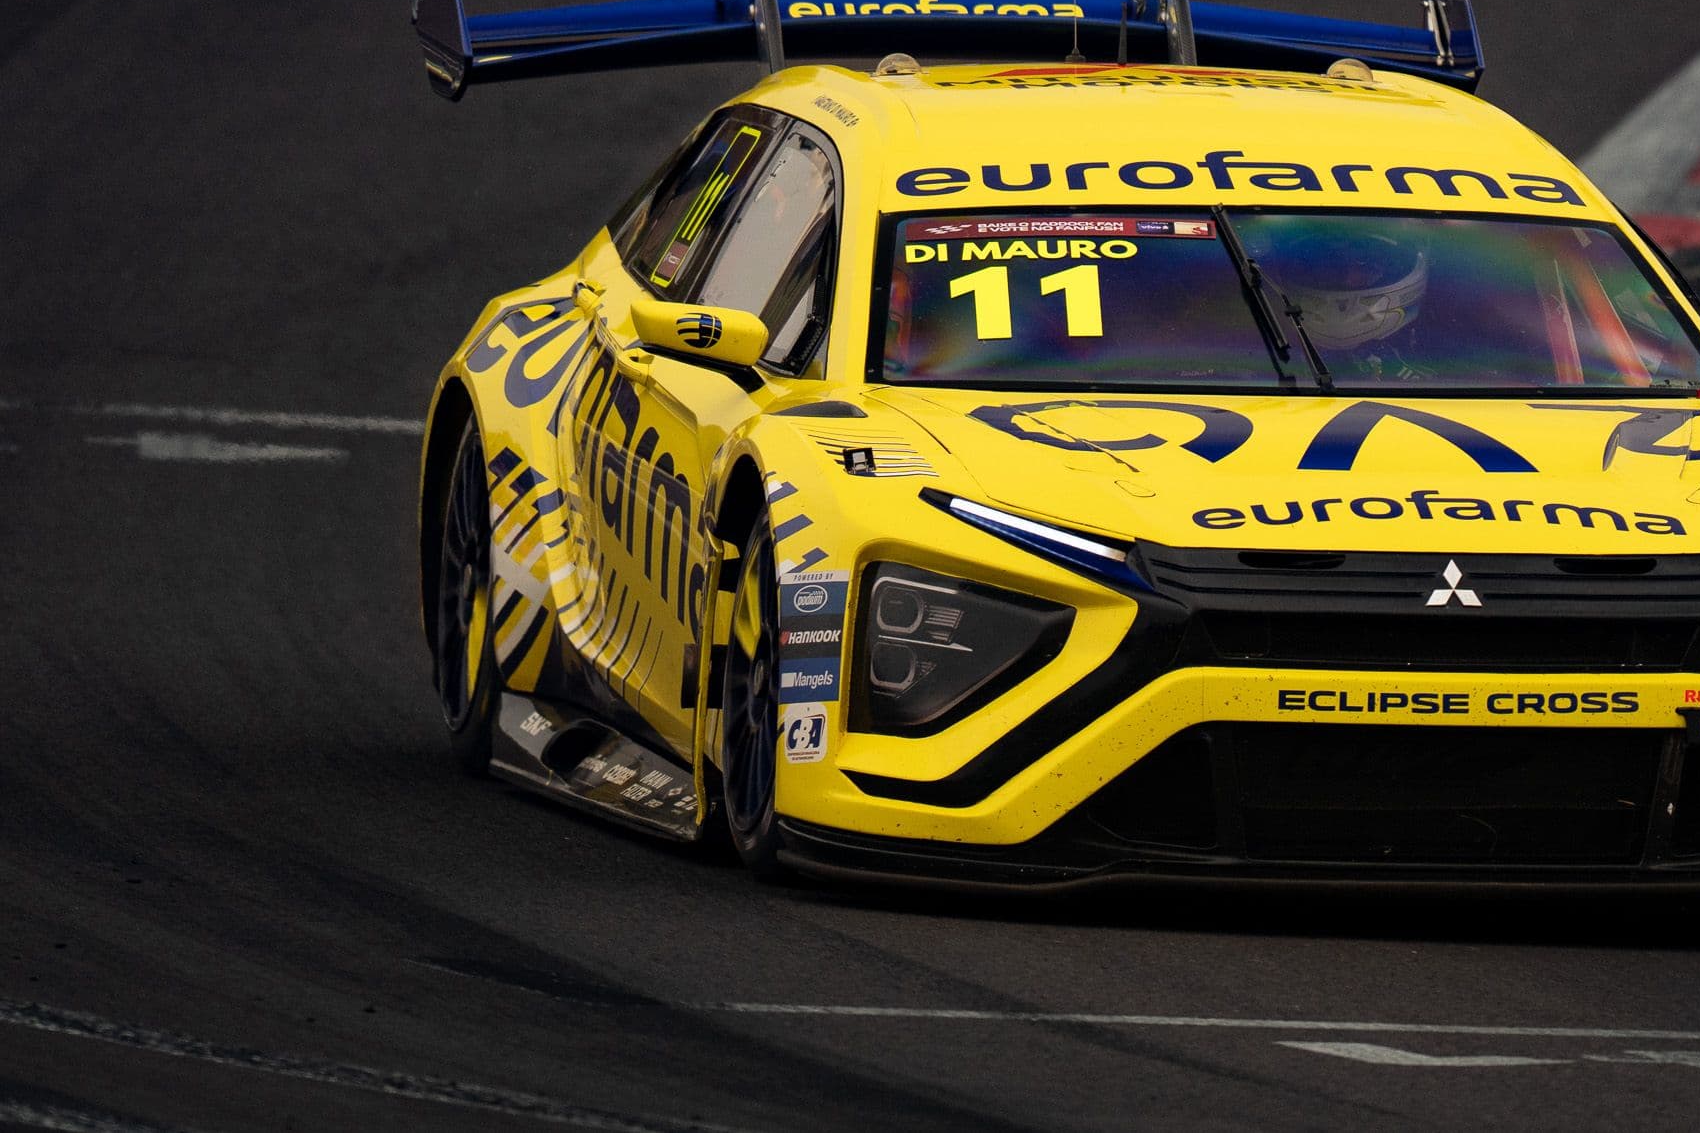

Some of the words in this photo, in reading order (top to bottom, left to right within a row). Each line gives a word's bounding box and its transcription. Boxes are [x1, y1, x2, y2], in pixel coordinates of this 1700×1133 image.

[895, 150, 1588, 207] eurofarma
[904, 242, 949, 264] DI
[961, 238, 1139, 262] MAURO
[949, 264, 1104, 341] 11
[1191, 490, 1687, 536] eurofarma
[793, 670, 834, 690] Mangels
[1277, 689, 1471, 715] ECLIPSE
[1486, 691, 1640, 715] CROSS
[787, 717, 823, 750] CBA
